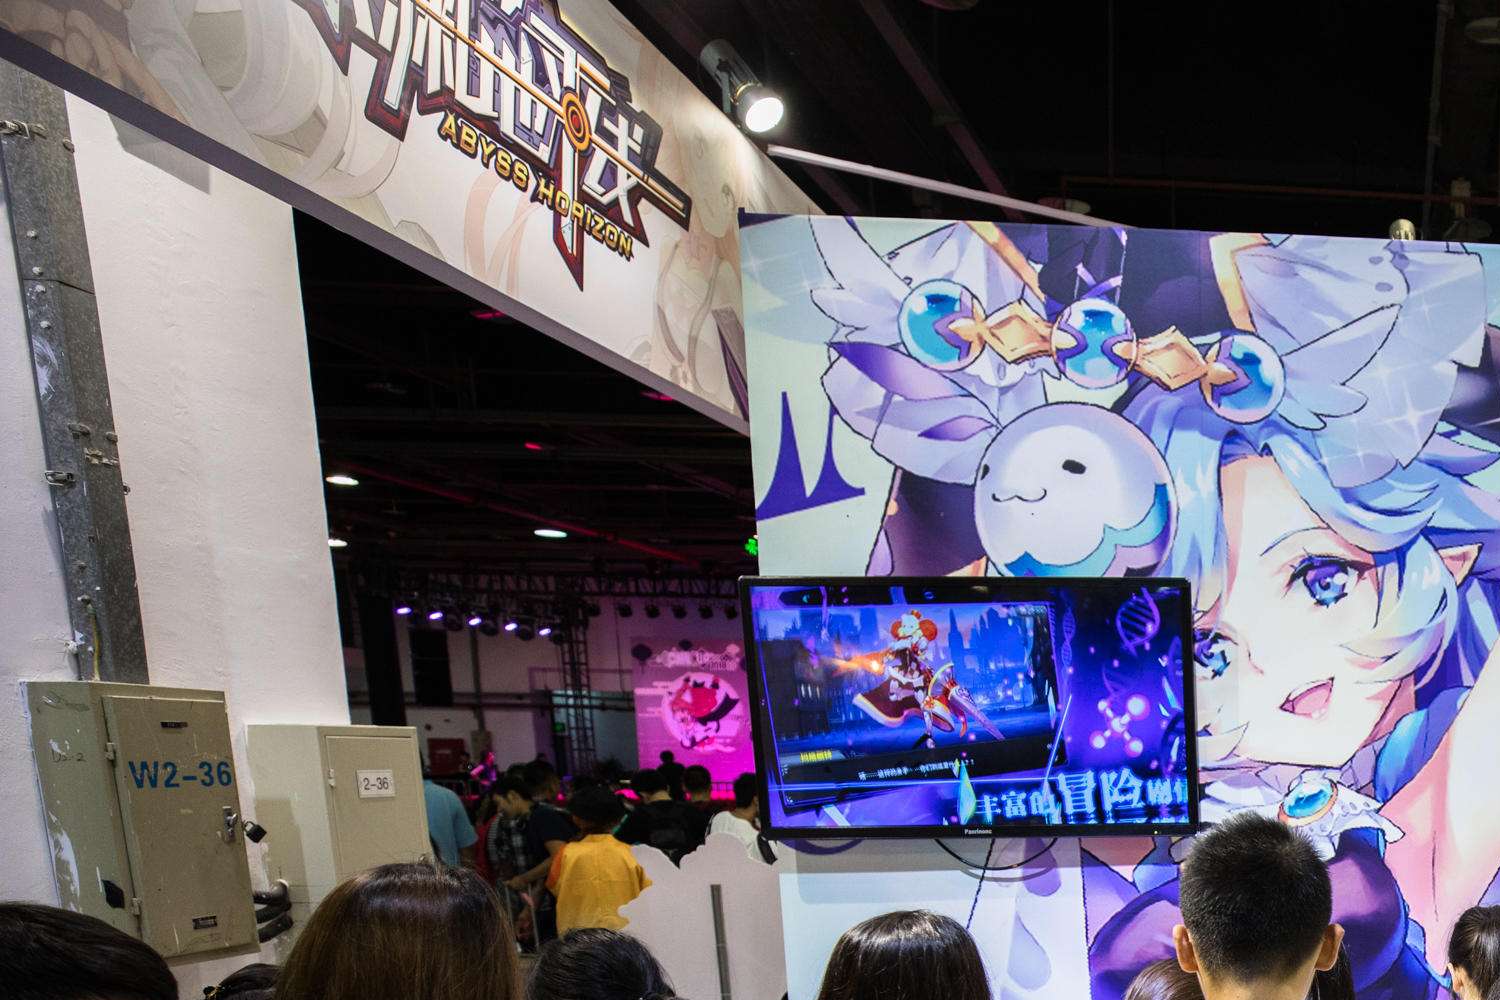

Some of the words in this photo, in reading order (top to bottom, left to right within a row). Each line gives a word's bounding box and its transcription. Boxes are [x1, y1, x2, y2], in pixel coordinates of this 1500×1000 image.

[439, 113, 530, 192] ABYSS
[537, 171, 634, 262] HORIZON
[128, 760, 233, 789] W2-36
[363, 776, 390, 791] 2-36
